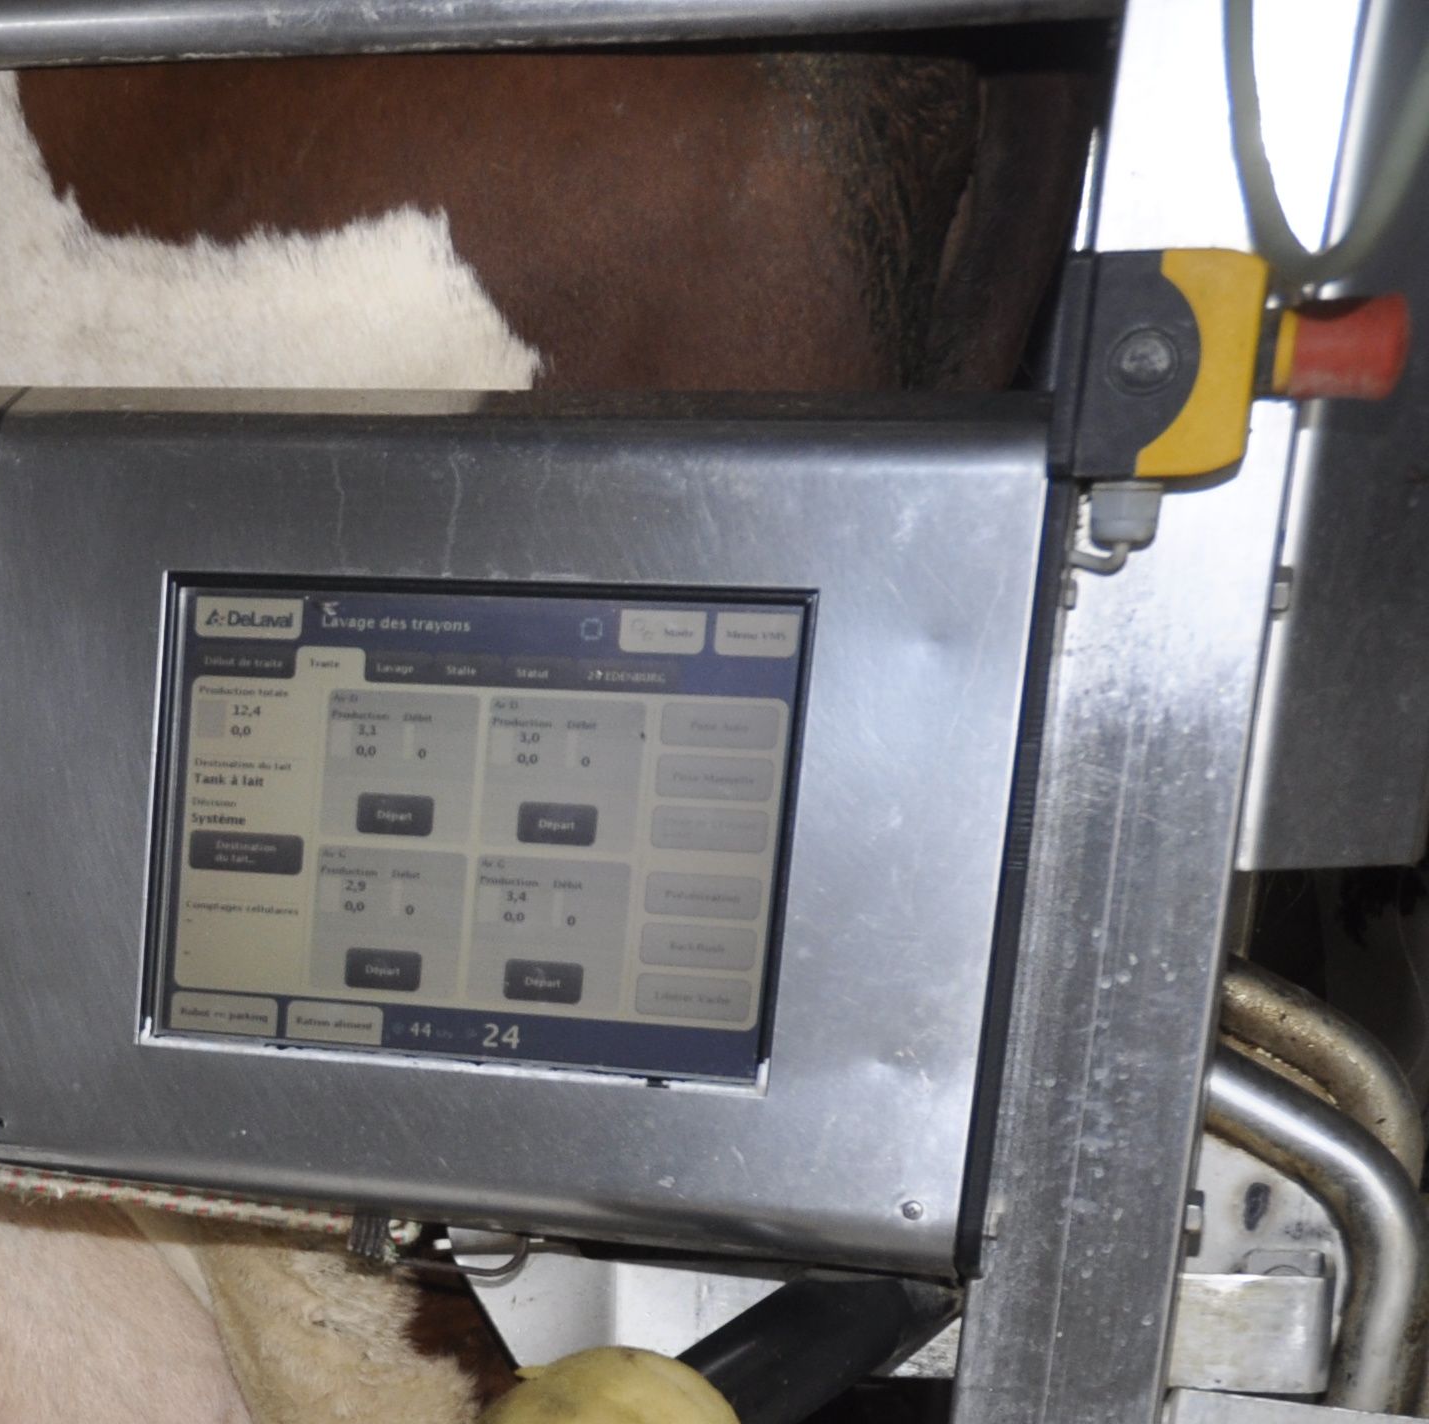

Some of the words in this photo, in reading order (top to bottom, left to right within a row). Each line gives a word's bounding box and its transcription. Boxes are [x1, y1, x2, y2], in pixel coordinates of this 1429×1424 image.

[228, 610, 293, 628] DeLaval
[322, 616, 375, 632] Lavage
[380, 616, 407, 630] des
[412, 619, 471, 634] trayons
[254, 658, 283, 668] traite
[376, 663, 414, 675] Lavage
[447, 665, 477, 676] Stalle
[199, 686, 256, 697] Production
[259, 688, 289, 698] totale
[232, 704, 261, 717] 12,4
[331, 710, 389, 721] Production
[492, 717, 552, 728] Production
[231, 725, 252, 738] 0,0
[355, 745, 377, 757] 0,0
[418, 748, 427, 759] 0
[195, 758, 255, 769] Destination
[259, 760, 271, 770] du
[275, 762, 292, 771] lait
[517, 753, 538, 766] 0,0
[581, 756, 590, 767] 0
[195, 773, 226, 785] Tank
[231, 774, 239, 785] à
[243, 775, 264, 787] lait
[191, 812, 246, 825] Système
[376, 810, 413, 822] Départ
[538, 819, 575, 831] Départ
[215, 840, 277, 852] Destination
[215, 854, 227, 863] du
[320, 865, 378, 877] Production
[345, 879, 366, 892] 2,9
[480, 875, 539, 887] Production
[507, 890, 526, 903] 3,4
[344, 900, 365, 913] 0,0
[405, 905, 414, 915] 0
[503, 912, 525, 923] 0,0
[567, 915, 576, 926] 0
[181, 1006, 209, 1018] Robot
[229, 1010, 269, 1023] parking
[297, 1016, 330, 1027] Ration
[410, 1022, 432, 1037] 44
[482, 1023, 521, 1049] 24
